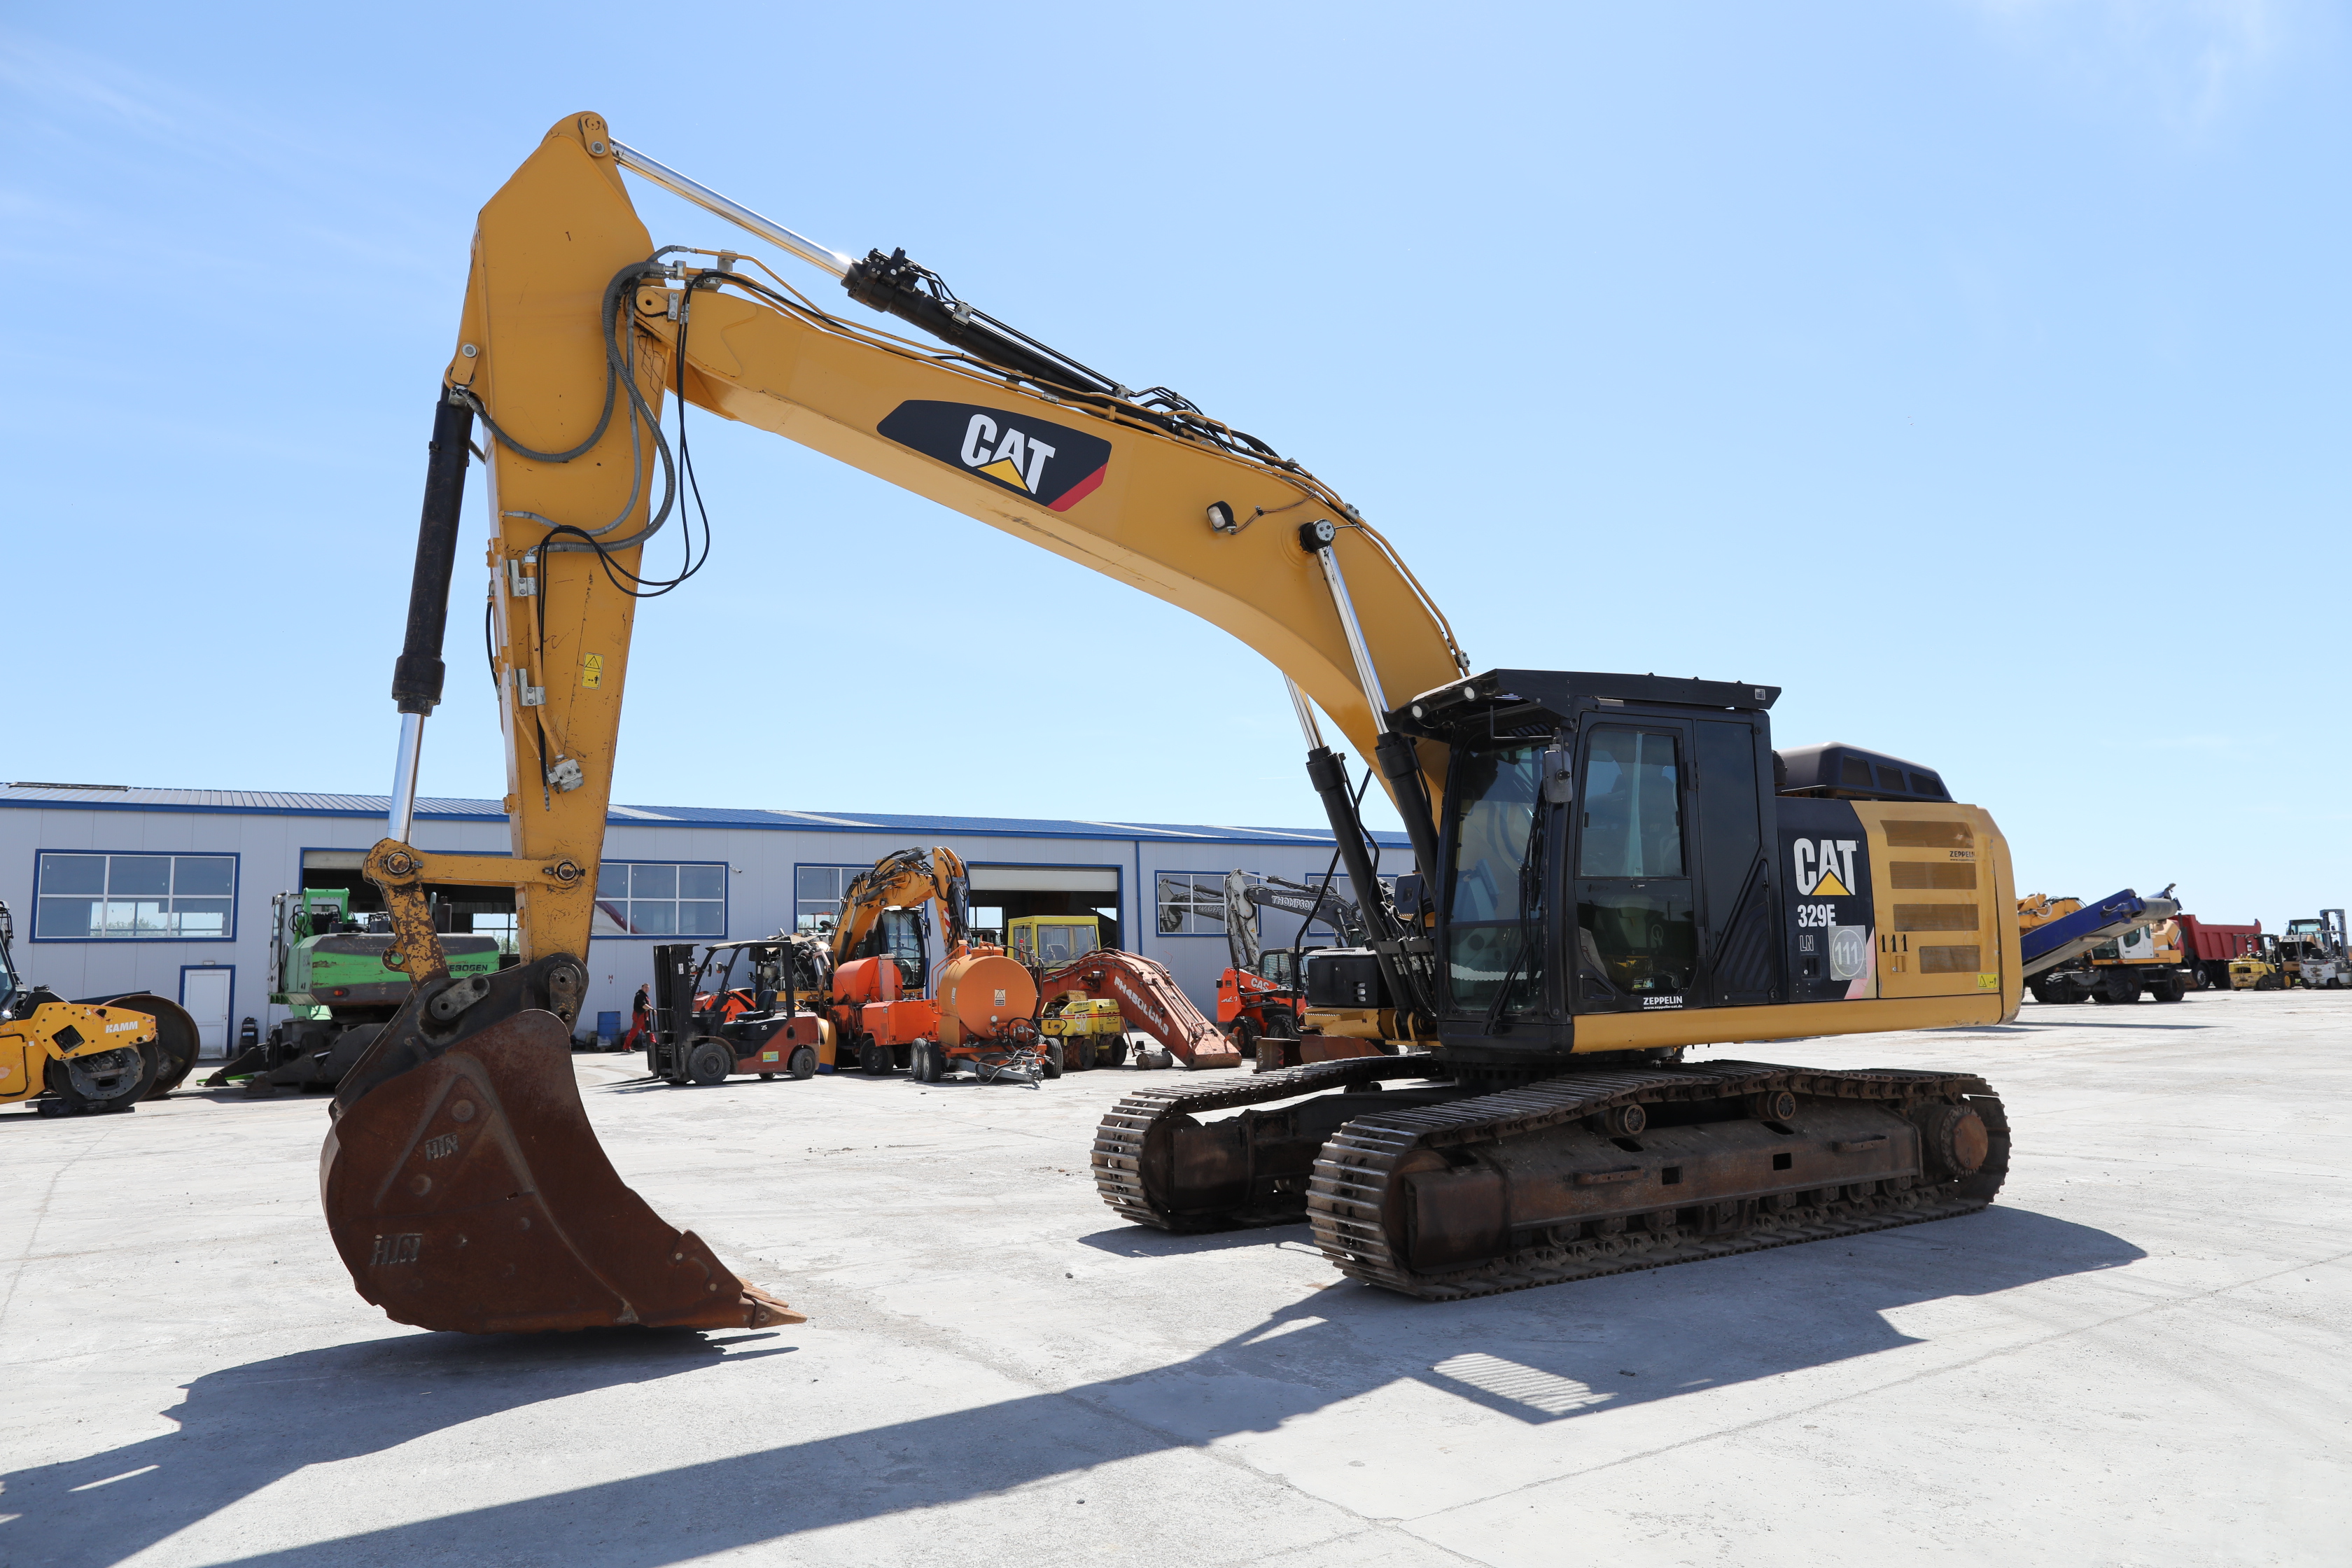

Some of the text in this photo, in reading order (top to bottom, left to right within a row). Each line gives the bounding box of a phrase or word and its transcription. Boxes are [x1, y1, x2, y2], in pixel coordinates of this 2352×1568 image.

[961, 414, 1056, 494] CAT
[1794, 838, 1856, 895] CAT
[1271, 895, 1320, 912] THOMPSON
[1798, 904, 1836, 927] 329E
[1800, 935, 1814, 951] LN
[1835, 941, 1858, 965] 111
[1643, 996, 1683, 1005] ZEPPELIN
[1074, 1013, 1087, 1032] 98
